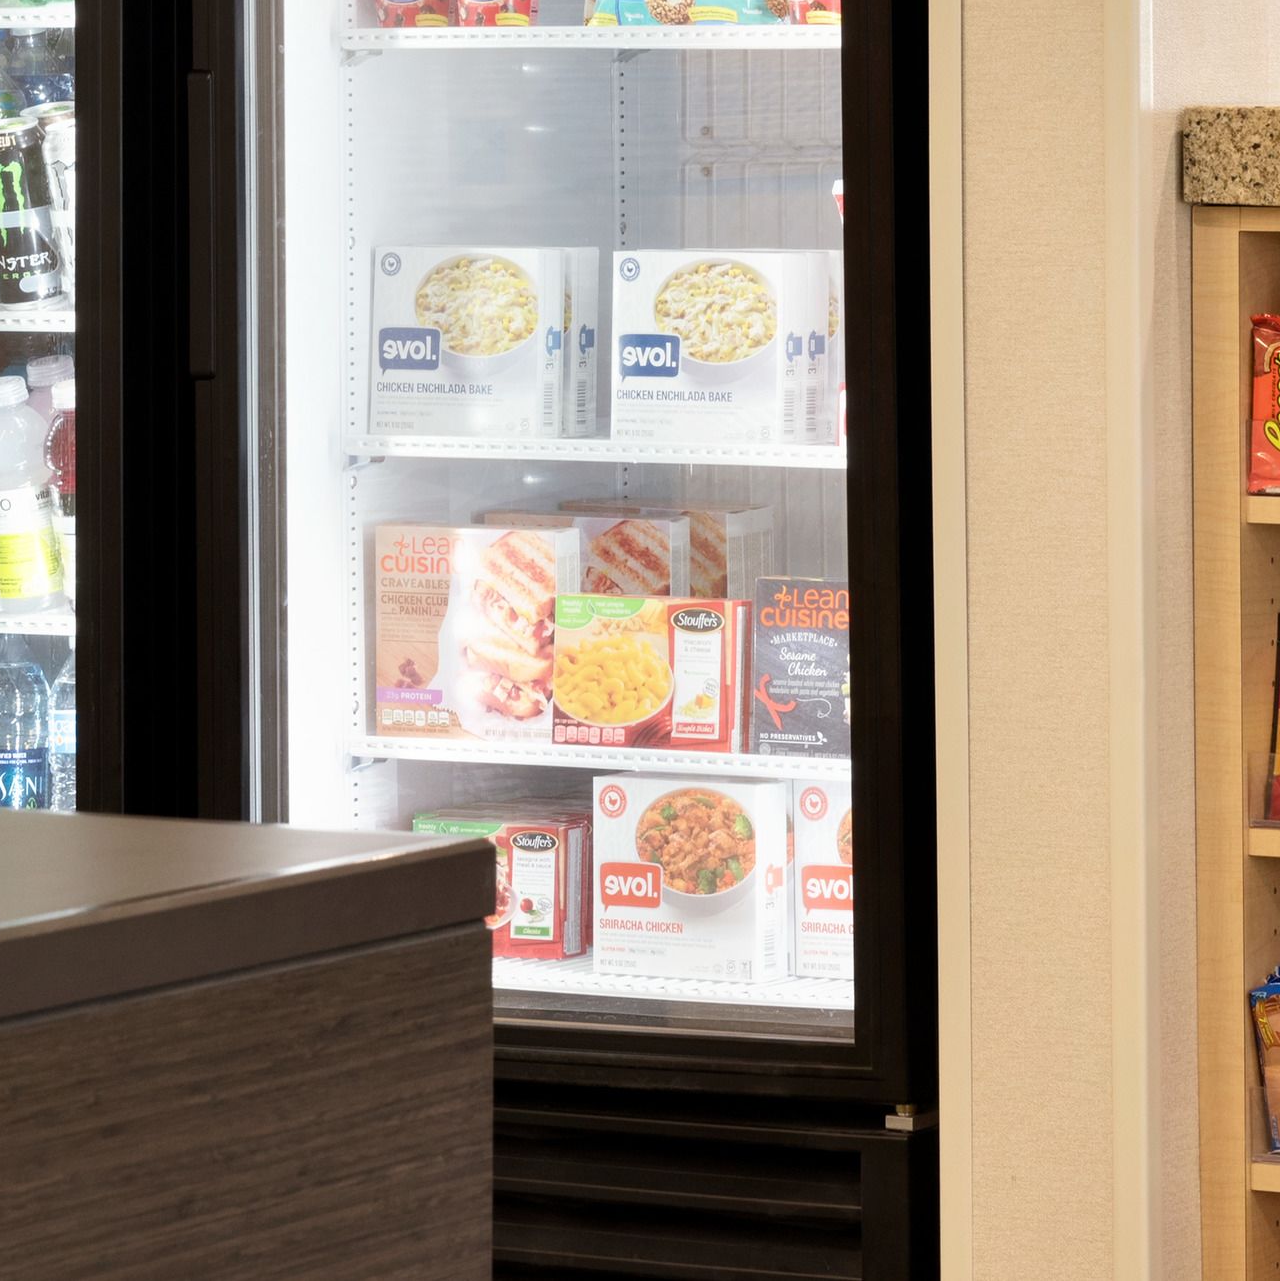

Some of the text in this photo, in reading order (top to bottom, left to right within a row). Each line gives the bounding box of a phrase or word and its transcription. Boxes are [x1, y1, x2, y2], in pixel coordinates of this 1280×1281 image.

[376, 382, 493, 395] CHICKEN ENCHILADA BAKE
[616, 389, 733, 402] CHICKEN ENCHILADA BAKE
[380, 578, 450, 590] CRAVEABLES
[380, 594, 449, 606] CHICKEN CLUB
[792, 589, 850, 610] Lean
[399, 606, 432, 616] PANINI
[677, 614, 718, 629] Stouffer's
[772, 632, 835, 647] MARKETPLACE
[779, 647, 816, 662] Sesame
[787, 662, 827, 676] Chicken
[400, 692, 432, 701] PROTEIN
[770, 733, 816, 742] PRESERVATIVES
[515, 835, 553, 849] Stouffer's
[599, 918, 683, 934] SRIRACHA CHICKEN
[801, 921, 846, 935] SRIRACHA
